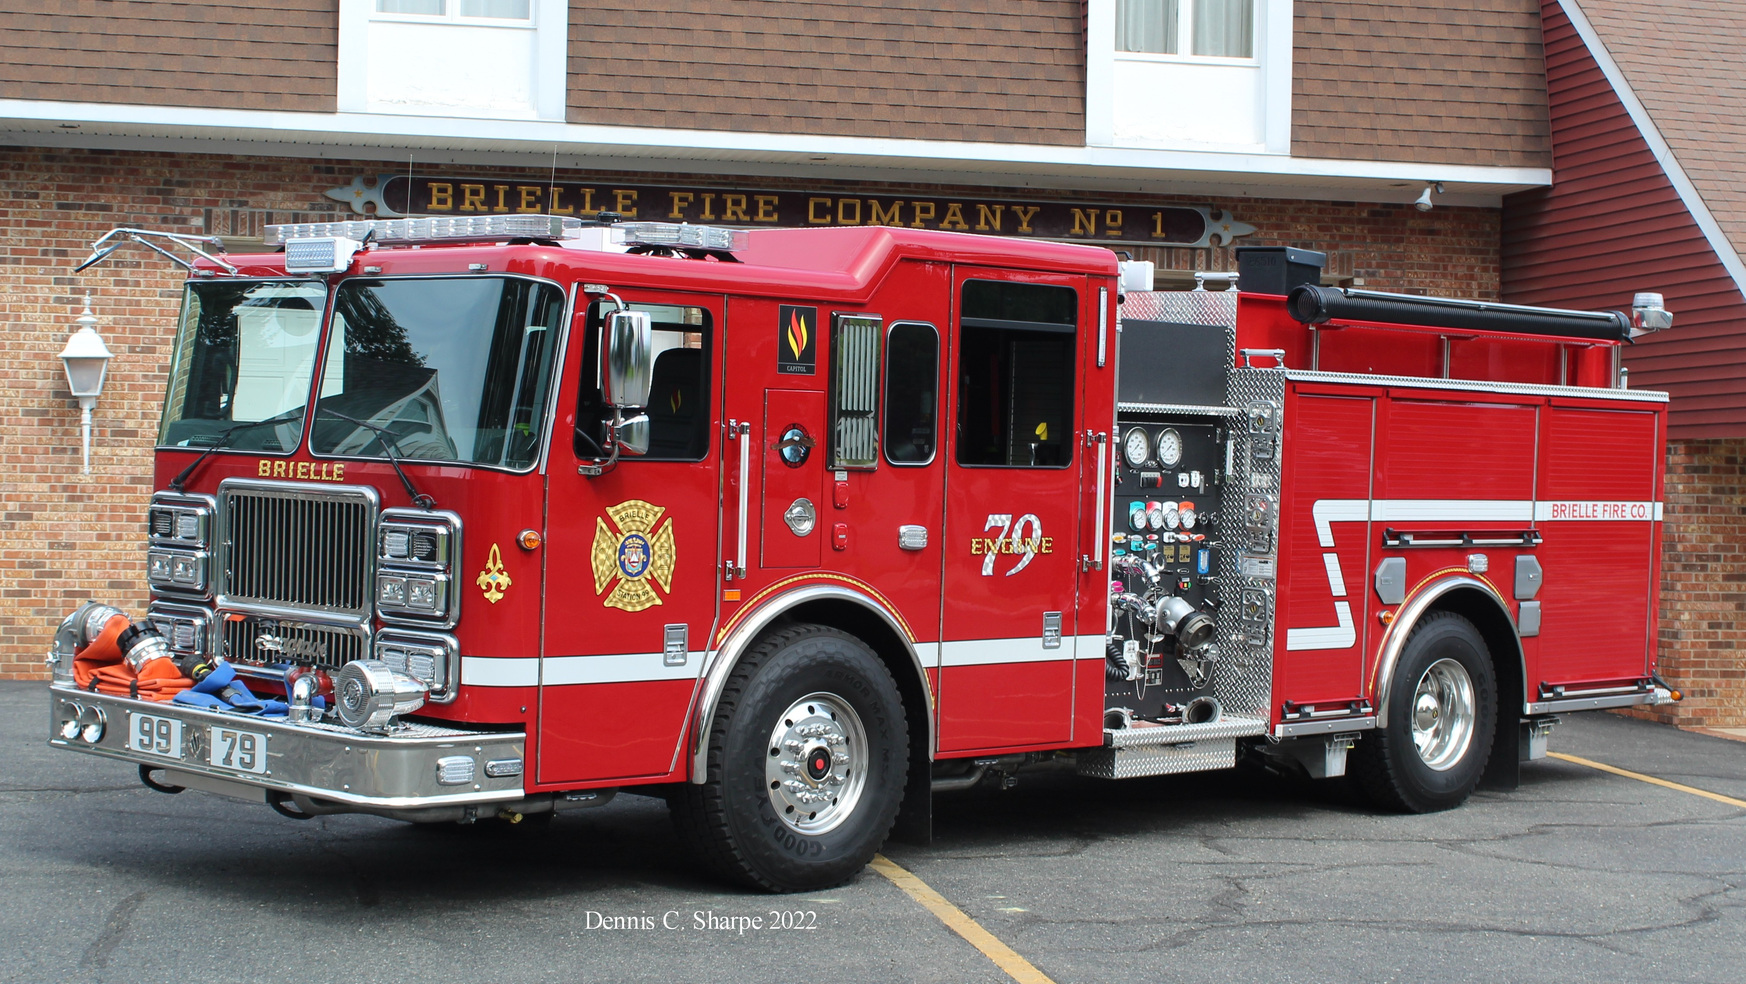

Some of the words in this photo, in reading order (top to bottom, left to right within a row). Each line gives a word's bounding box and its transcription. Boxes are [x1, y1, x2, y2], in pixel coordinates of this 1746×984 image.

[427, 182, 638, 217] BRIELLE
[668, 191, 779, 222] FIRE
[808, 197, 1041, 233] COMPANY
[1152, 211, 1166, 238] 1
[786, 365, 807, 373] CAPITOL
[257, 459, 345, 481] BRIELLE
[618, 510, 650, 523] BRIELLE
[1552, 503, 1598, 518] BRIELLE
[1602, 504, 1627, 518] FIRE
[1630, 504, 1648, 518] CO.
[971, 537, 1054, 555] ENGINE
[981, 513, 1043, 577] 79
[616, 589, 641, 601] STATION
[641, 589, 650, 598] 99
[823, 669, 870, 699] ARMOR
[870, 701, 889, 741] MAX
[139, 716, 172, 754] 99
[221, 730, 256, 770] 79
